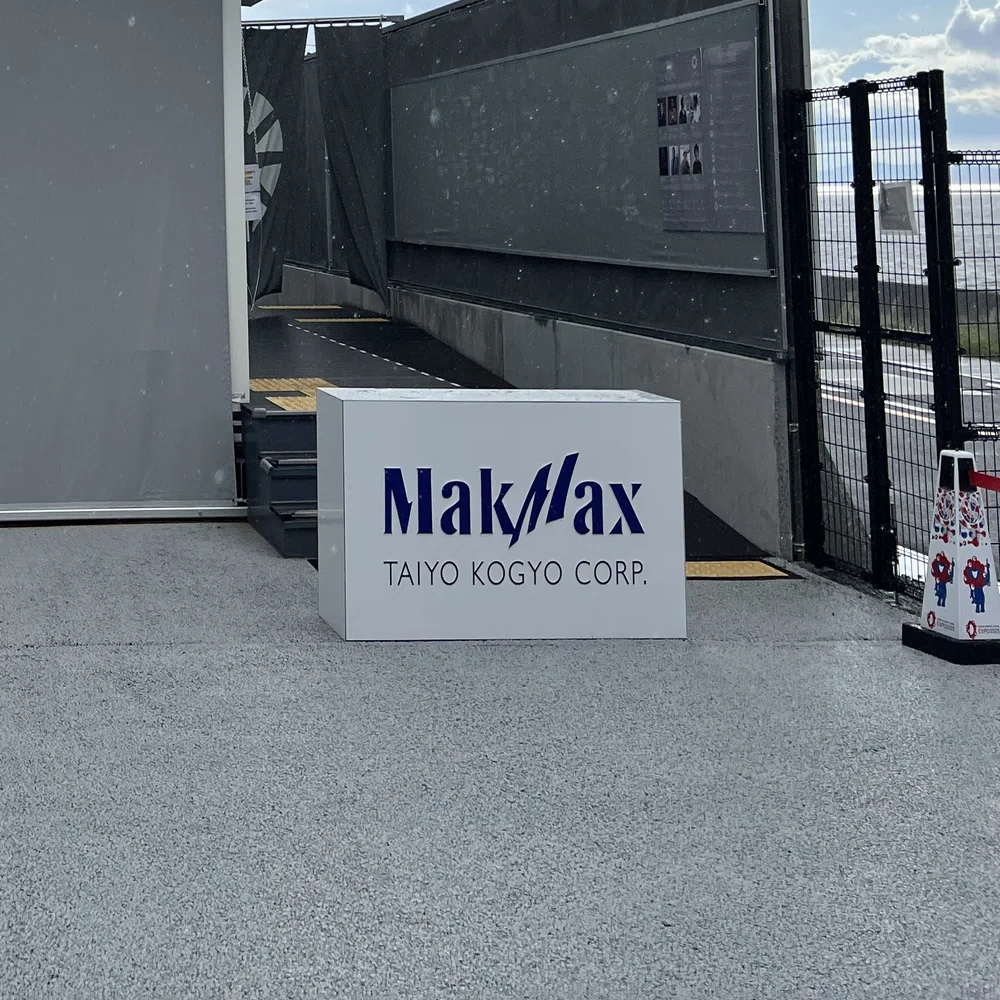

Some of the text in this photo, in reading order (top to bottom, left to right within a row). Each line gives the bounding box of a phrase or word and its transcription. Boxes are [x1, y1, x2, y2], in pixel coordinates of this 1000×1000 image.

[383, 452, 646, 550] MakMax
[383, 560, 647, 586] TAIYO KOGYO CORP.
